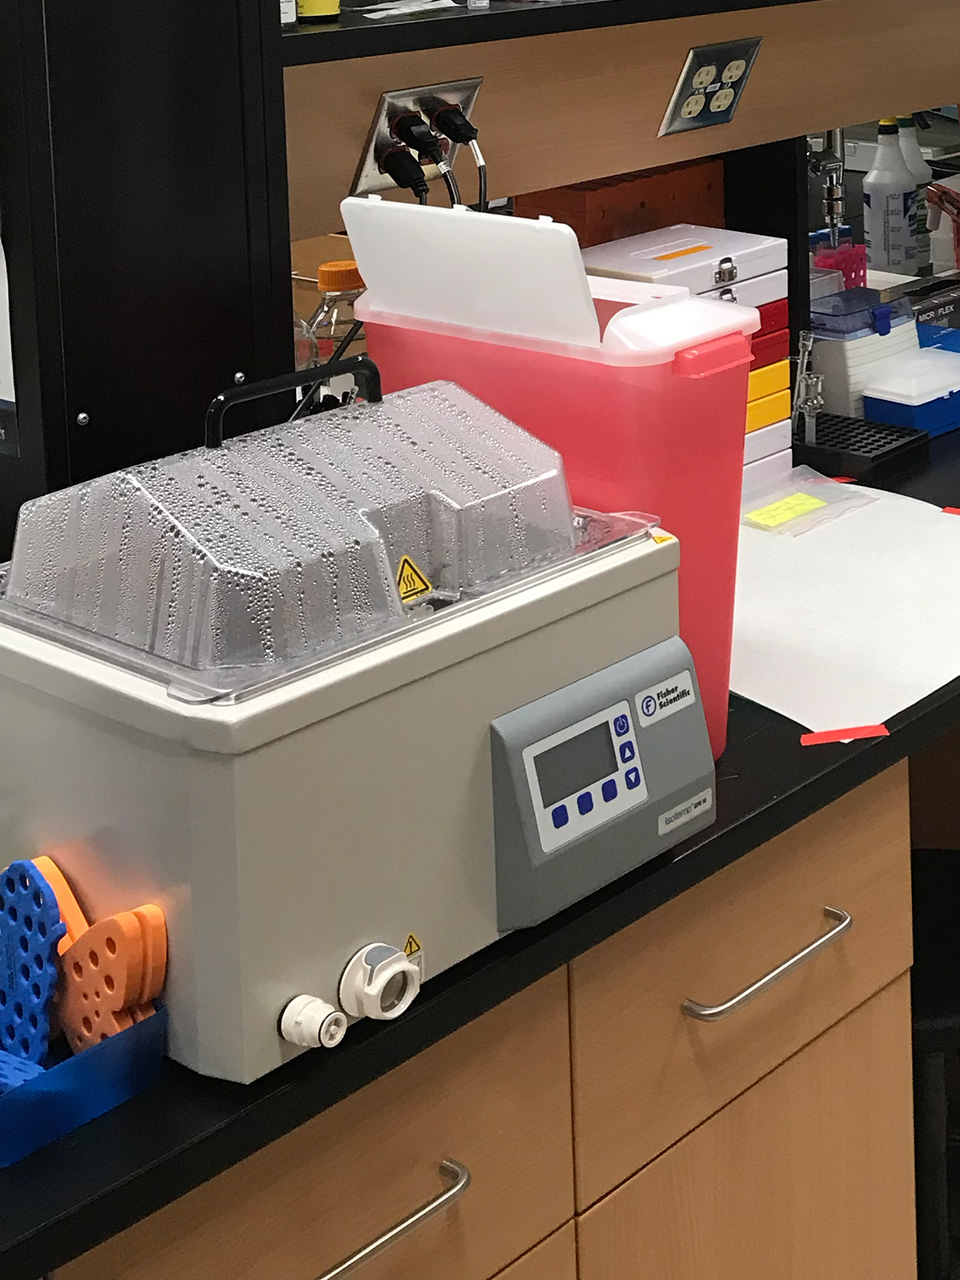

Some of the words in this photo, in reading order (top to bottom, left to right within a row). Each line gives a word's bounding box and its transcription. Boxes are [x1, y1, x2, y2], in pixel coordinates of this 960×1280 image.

[918, 304, 955, 321] MICRFLEX
[656, 686, 678, 700] Fisher
[659, 690, 690, 710] Scientific
[665, 804, 691, 825] Isotemp
